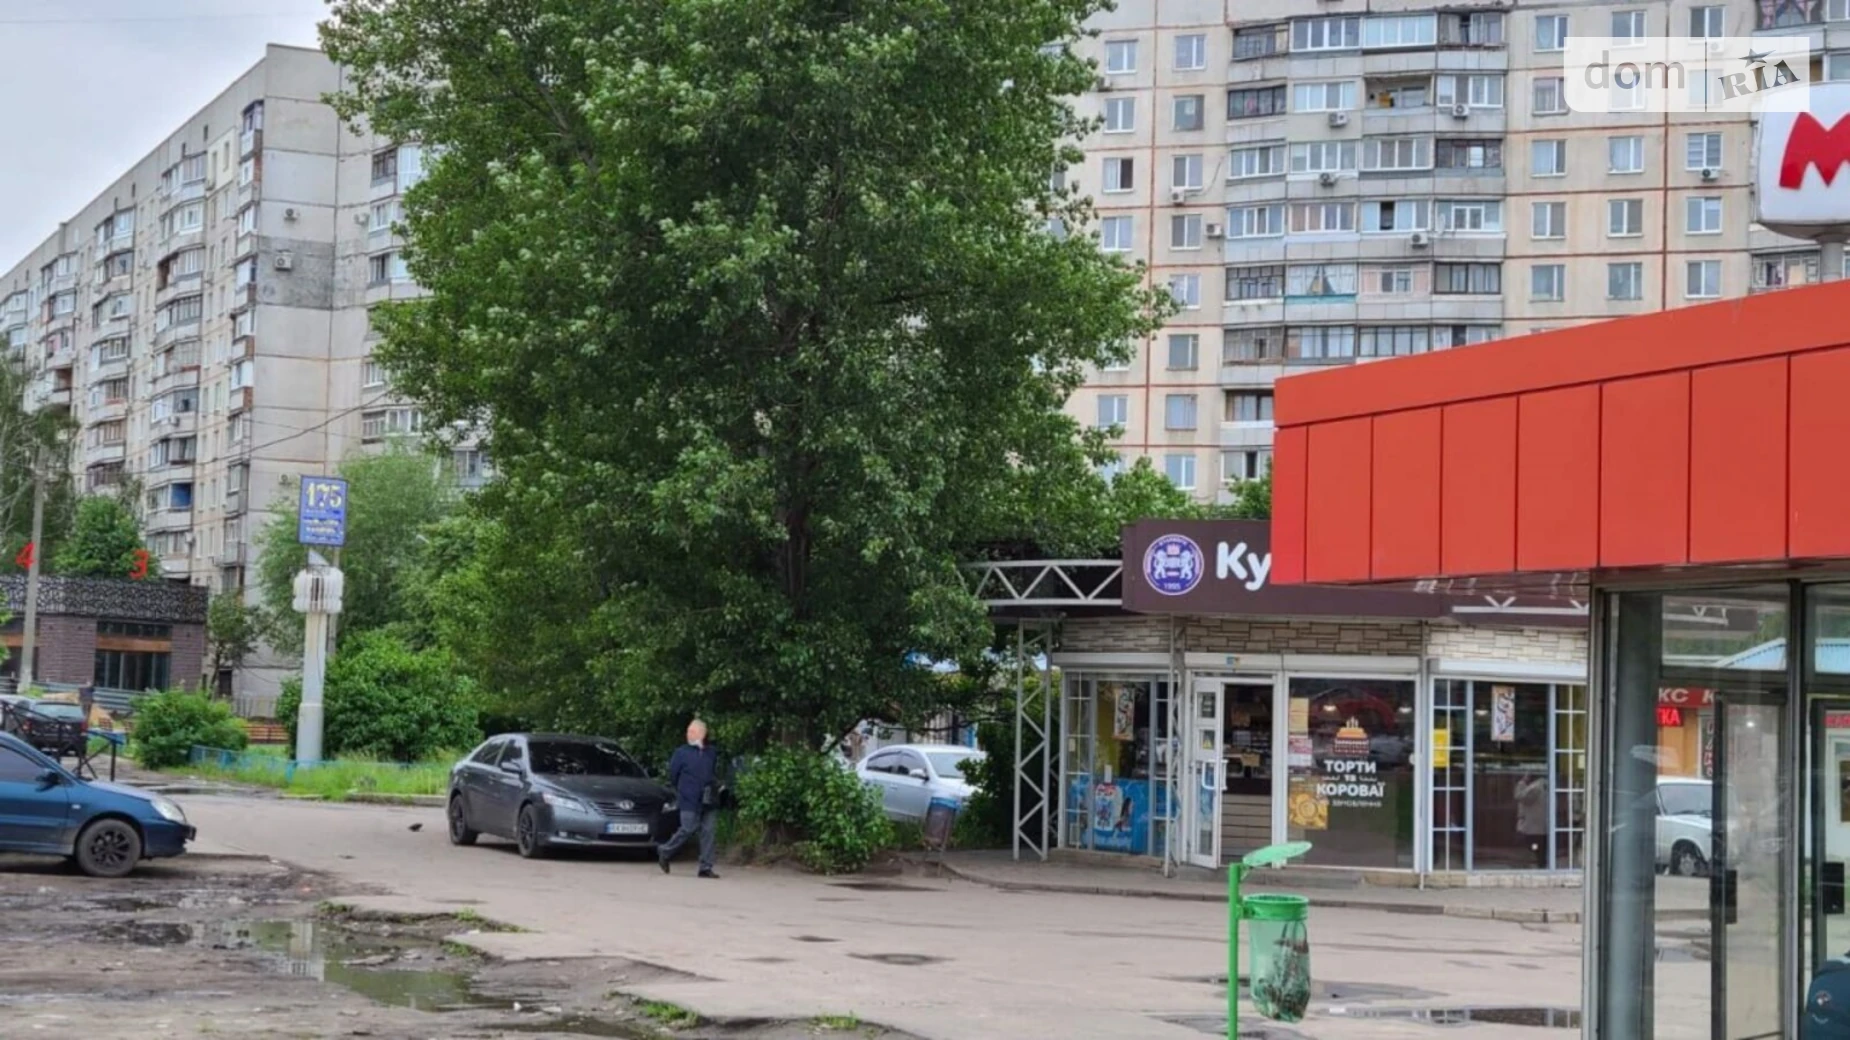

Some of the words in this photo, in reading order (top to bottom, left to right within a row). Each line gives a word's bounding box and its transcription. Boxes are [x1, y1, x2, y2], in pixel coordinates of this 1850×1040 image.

[306, 482, 342, 508] 175
[1324, 759, 1377, 774] ТОРТИ
[1316, 781, 1386, 797] КОРОВАЇ
